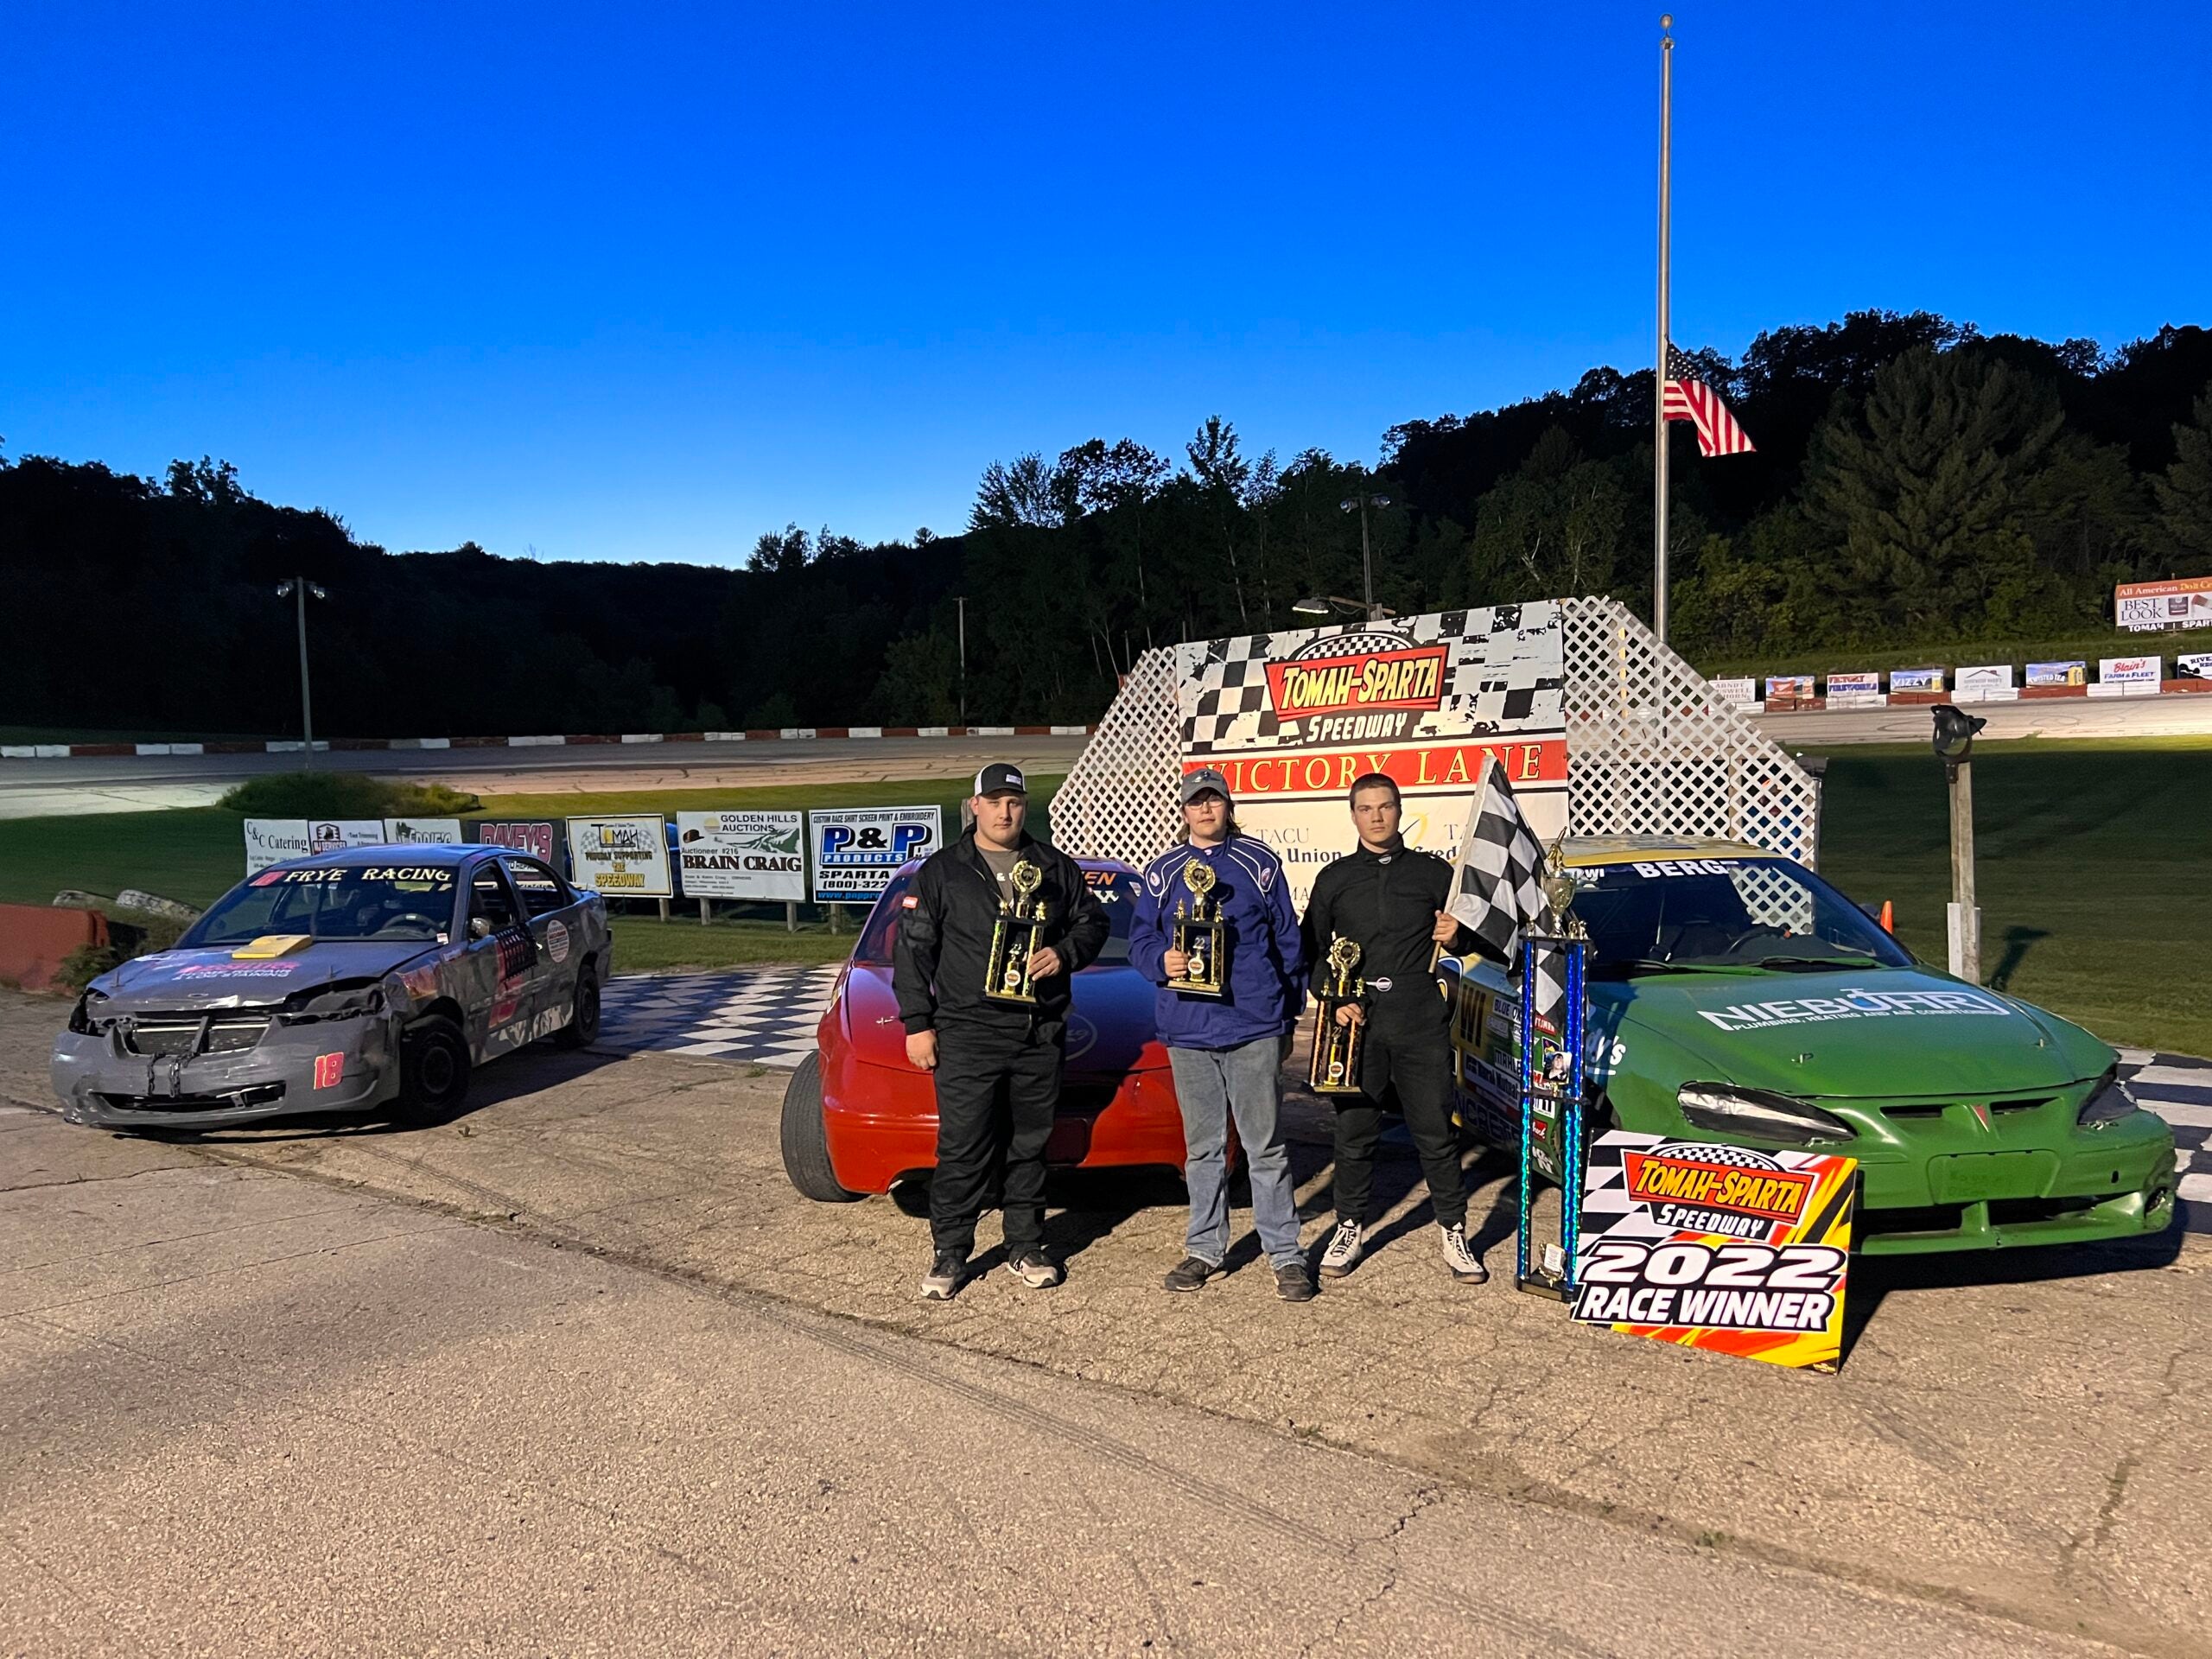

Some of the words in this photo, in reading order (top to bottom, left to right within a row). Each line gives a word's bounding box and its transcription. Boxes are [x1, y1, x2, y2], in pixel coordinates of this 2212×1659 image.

[2135, 585, 2177, 594] American
[2125, 598, 2159, 610] BEST
[2121, 608, 2163, 621] LOOK
[2128, 622, 2164, 632] TOMAH
[2113, 659, 2146, 673] Blain's
[1281, 657, 1440, 710] TOMAH-SPARTA
[1892, 677, 1928, 686] VIZZY
[1306, 713, 1408, 742] SPEEDWAY
[1205, 753, 1392, 793] VICTORY
[247, 822, 252, 835] C
[252, 827, 259, 841] &
[259, 834, 265, 848] C
[268, 835, 308, 853] Catering
[480, 823, 553, 864] DAVEY'S
[822, 823, 933, 855] P&P
[613, 851, 653, 861] SUPPORTING
[683, 855, 741, 870] BRAIN
[744, 856, 802, 872] CRAIG
[824, 854, 904, 863] PRODUCTS
[1287, 848, 1342, 863] Union
[283, 868, 347, 883] FRYE
[361, 867, 451, 881] RACING
[612, 862, 626, 872] THE
[819, 870, 890, 879] SPARTA
[1632, 859, 1739, 879] BERG
[594, 873, 645, 887] SPEEDWAY
[1082, 871, 1117, 886] EN
[1494, 998, 1510, 1017] BLUE
[1697, 992, 1993, 1031] NIEBUHR
[1732, 1017, 1806, 1031] PLUMBING,
[1808, 1012, 1861, 1022] HEATING
[314, 1051, 345, 1090] 18
[1635, 1160, 1805, 1214] TOMAH-SPARTA
[1657, 1205, 1764, 1237] SPEEDWAY
[1584, 1243, 1845, 1289] 2022
[1580, 1287, 1674, 1324] RACE
[1679, 1288, 1833, 1330] WINNER
